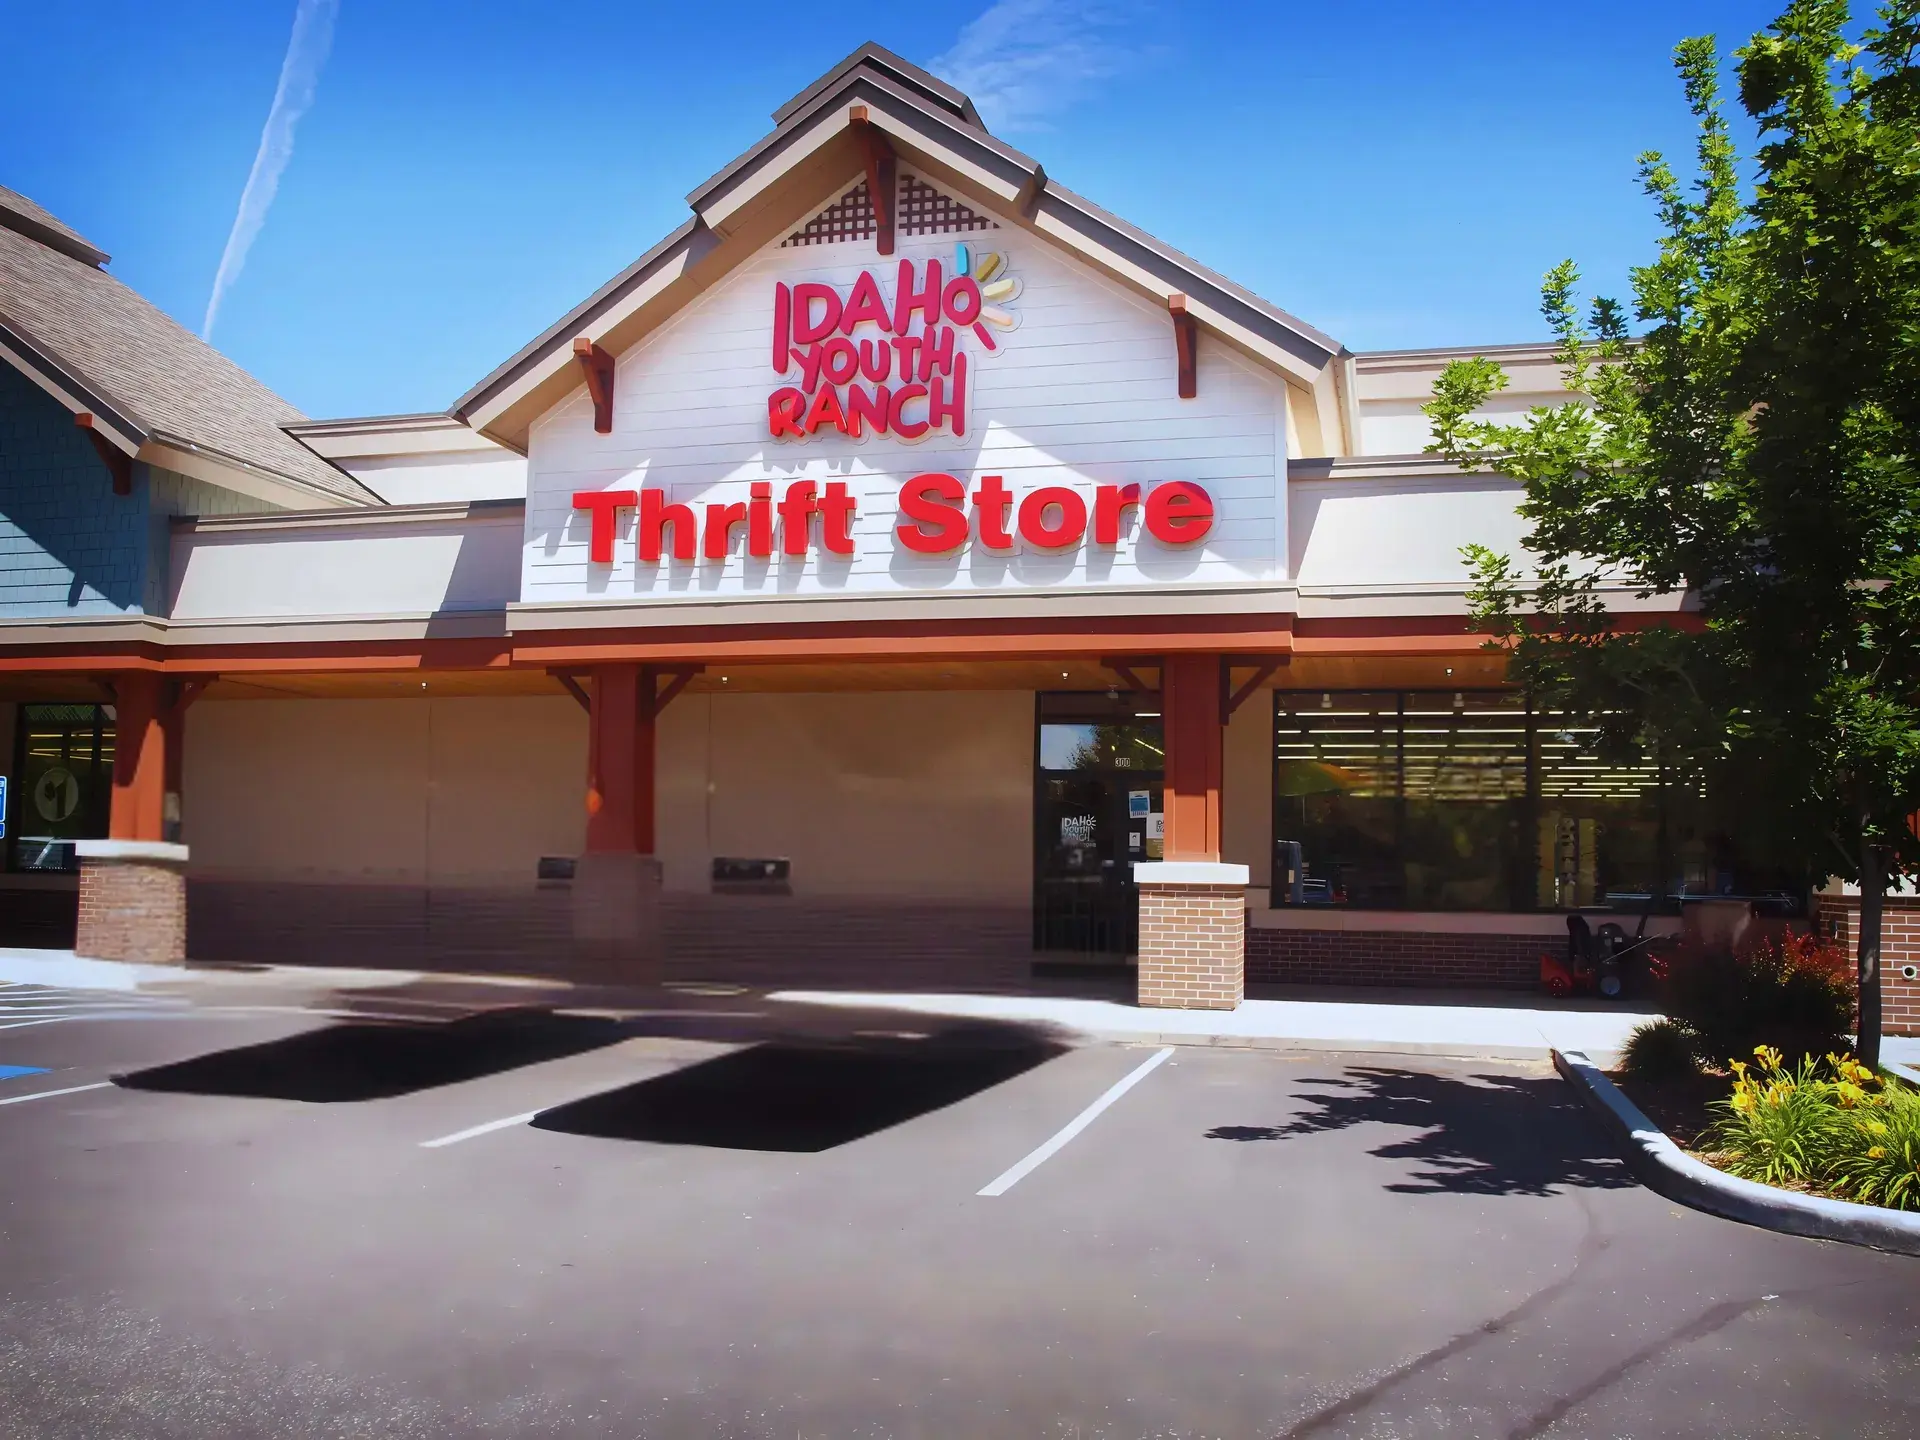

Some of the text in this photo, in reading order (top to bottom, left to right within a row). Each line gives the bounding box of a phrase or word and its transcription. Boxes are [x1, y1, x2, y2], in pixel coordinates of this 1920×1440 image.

[773, 258, 982, 375] IDAHO
[789, 325, 955, 395] YOUTH
[768, 351, 967, 439] RANCH
[572, 472, 1214, 563] Thrift Store
[1062, 815, 1092, 838] IDAHO
